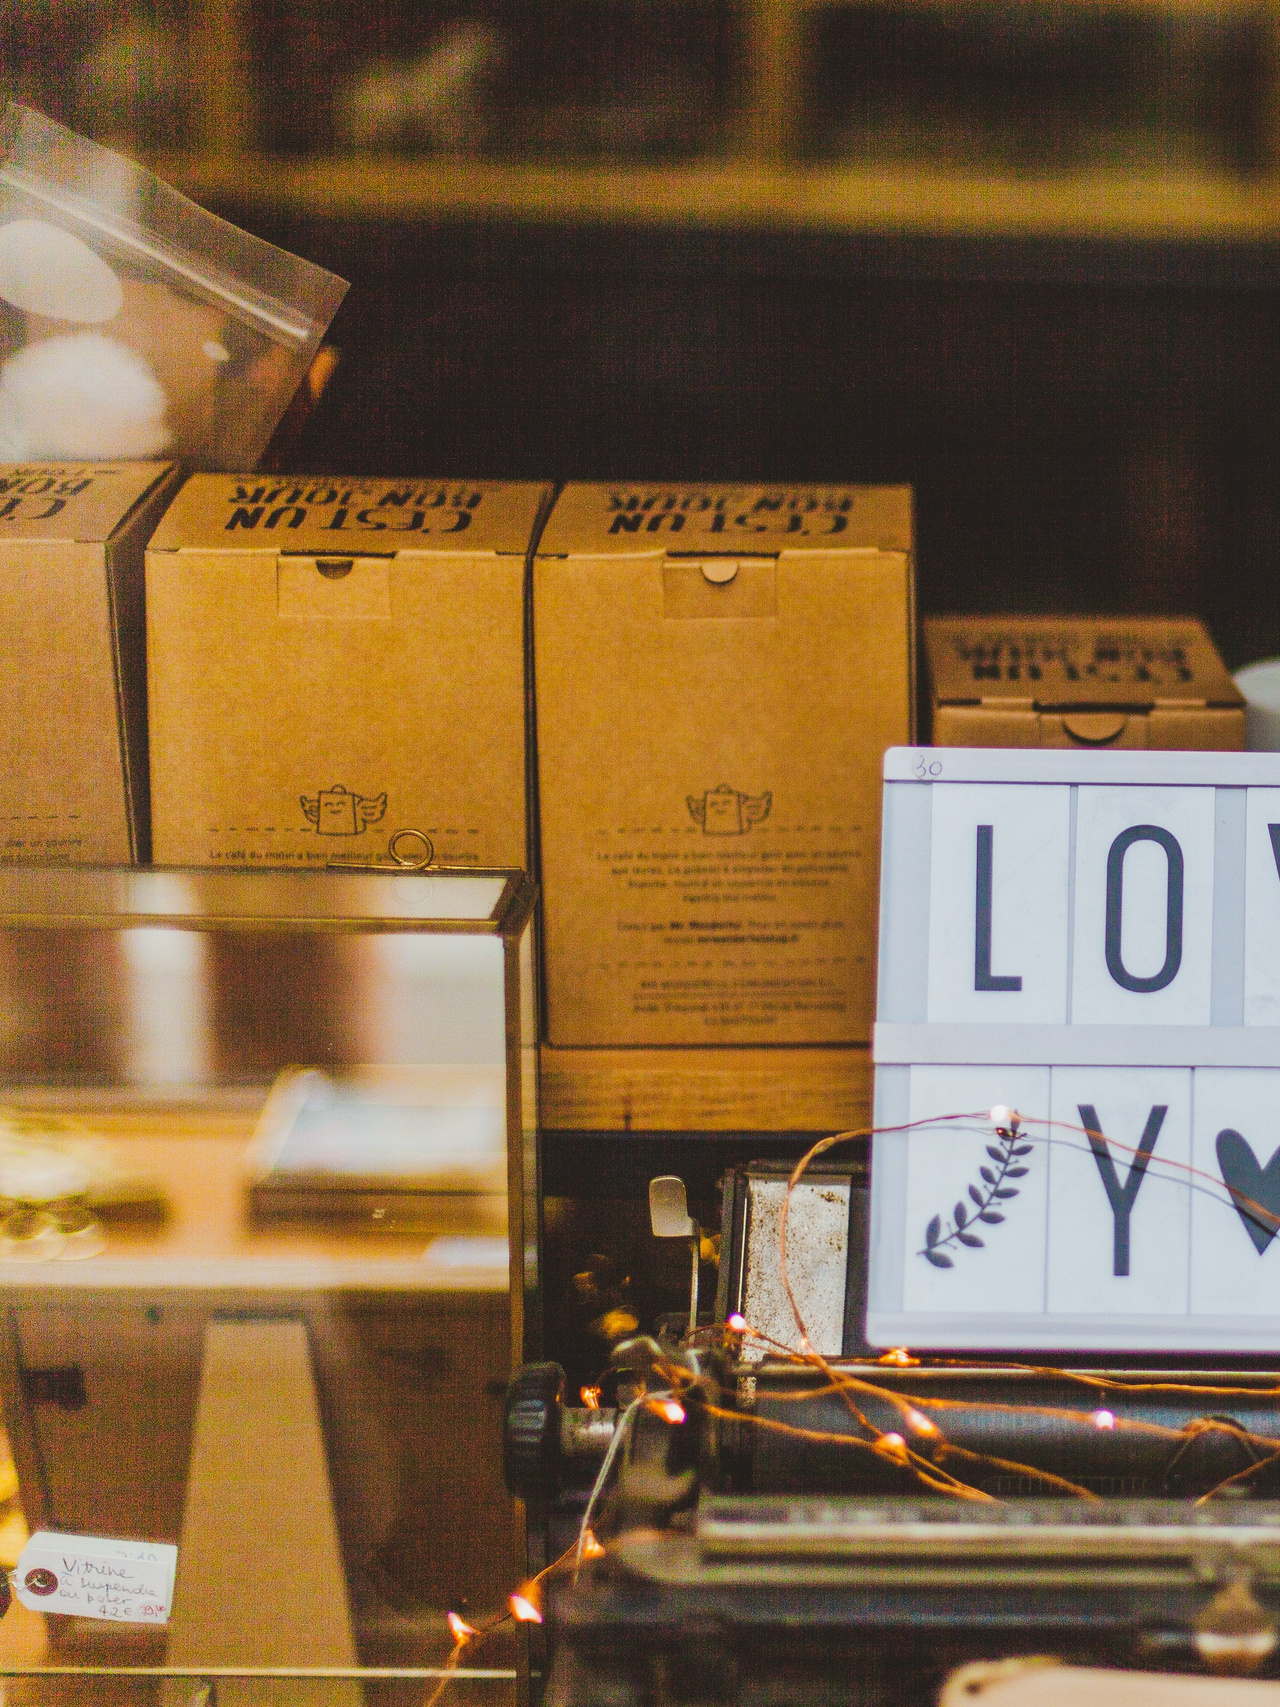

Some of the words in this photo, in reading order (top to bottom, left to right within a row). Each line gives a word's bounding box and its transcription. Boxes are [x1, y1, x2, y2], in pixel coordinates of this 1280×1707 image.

[225, 506, 307, 530] UN
[320, 507, 473, 534] C'EST
[607, 513, 687, 534] UN
[915, 754, 944, 779] 30
[63, 1557, 135, 1580] Vitrine
